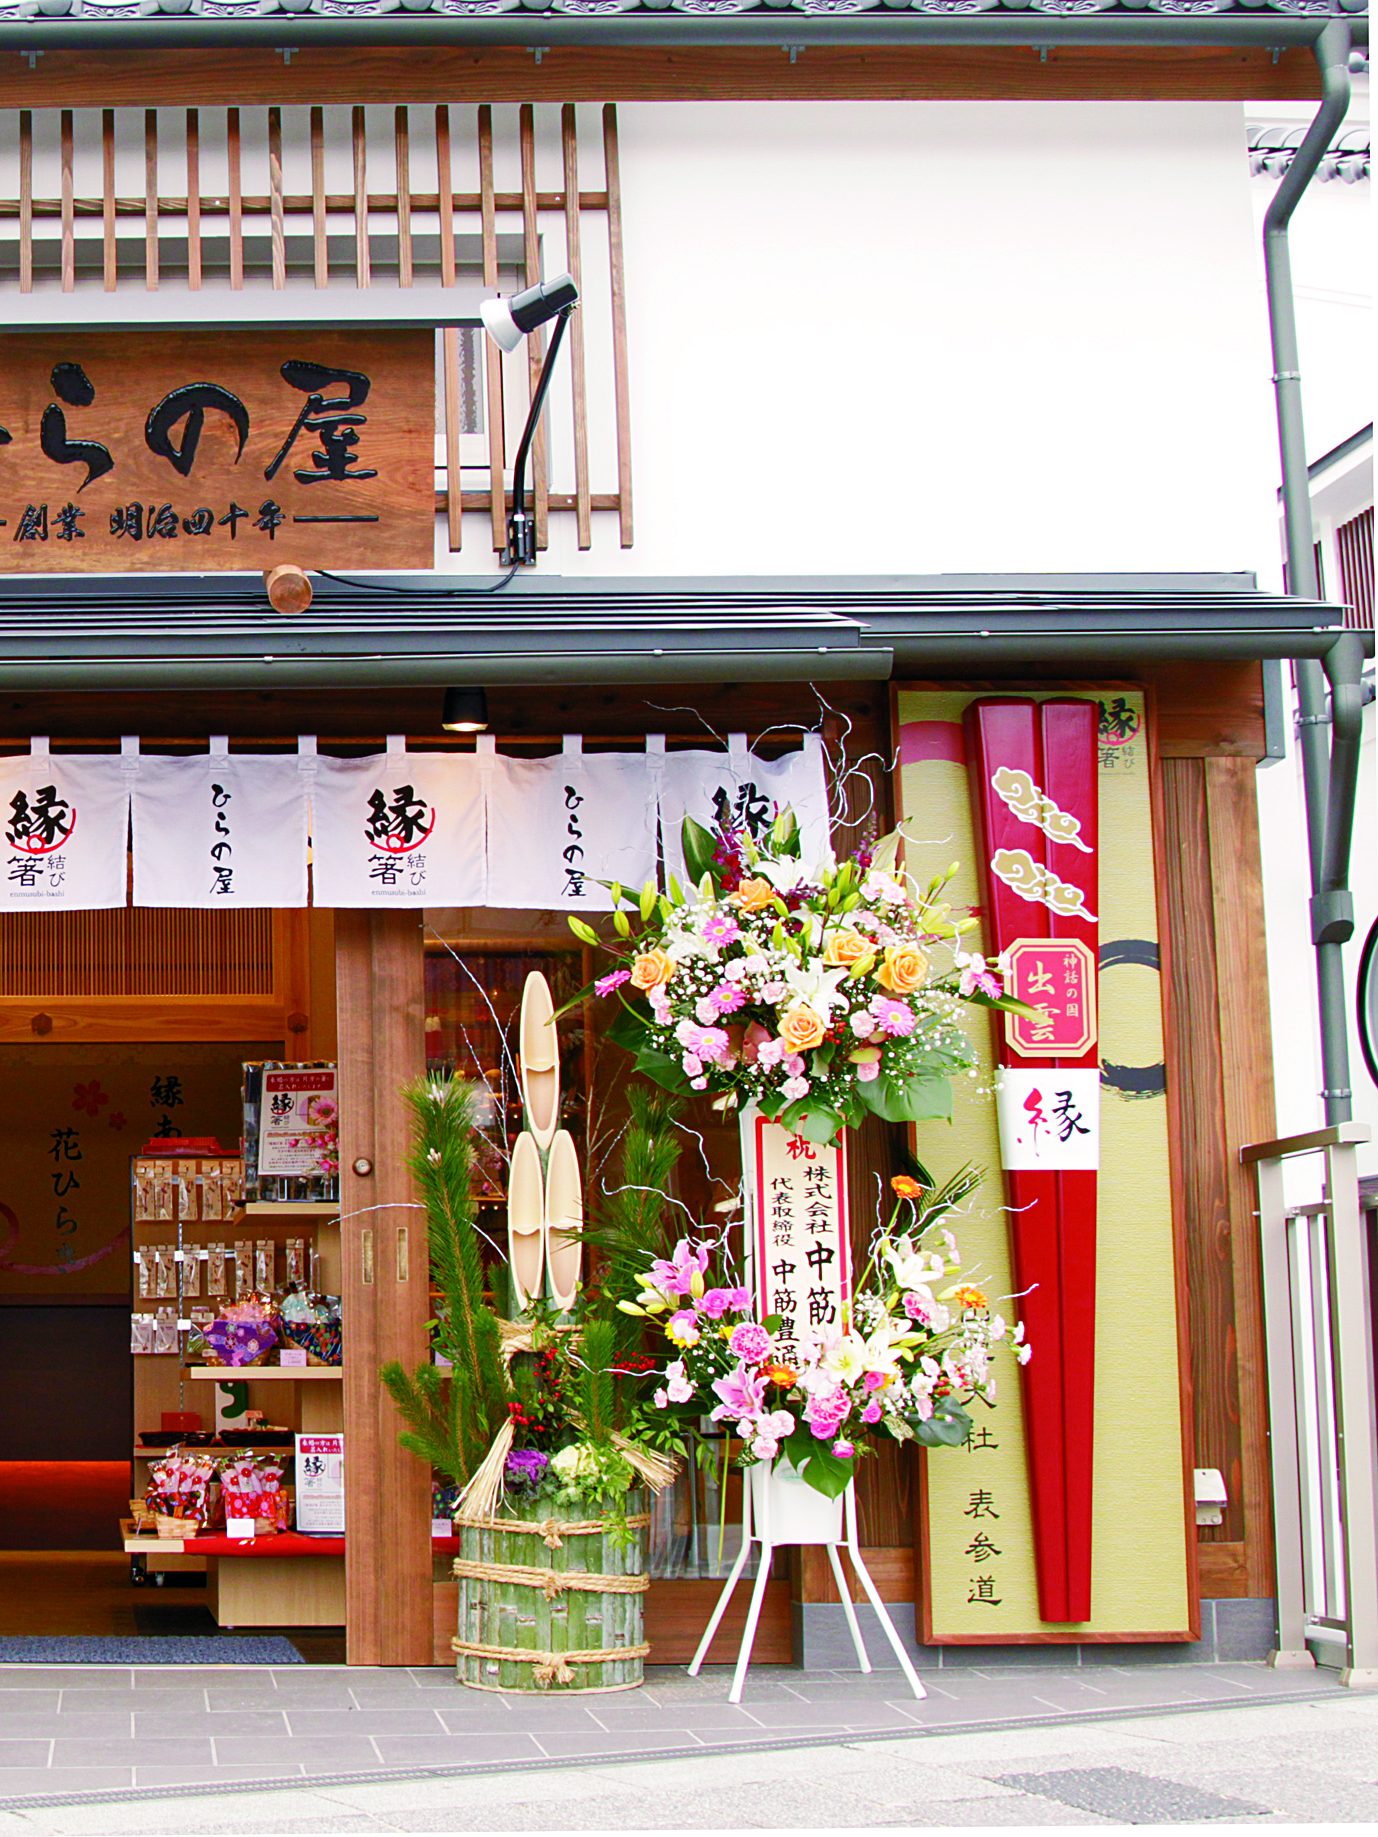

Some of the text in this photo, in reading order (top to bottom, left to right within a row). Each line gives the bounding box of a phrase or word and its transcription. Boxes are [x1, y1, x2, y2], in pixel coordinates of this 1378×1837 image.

[13, 500, 287, 543] 創業 明治四十年
[5, 785, 70, 844] 縁
[210, 783, 236, 895] ひらの屋
[364, 785, 429, 844] 縁
[561, 785, 589, 898] ひらの屋
[8, 855, 44, 888] 箸
[9, 890, 66, 898] enmusubi-bashi
[47, 854, 67, 888] 結び
[368, 853, 404, 886] 箸
[407, 853, 427, 887] 結び
[1025, 960, 1061, 1041] 出雲
[1063, 953, 1079, 1018] 神話の国
[270, 1093, 292, 1113] 縁
[1017, 1087, 1091, 1157] 縁
[786, 1134, 816, 1160] 祝
[771, 1177, 796, 1247] 代表取締役
[964, 1488, 1003, 1606] 表参道
